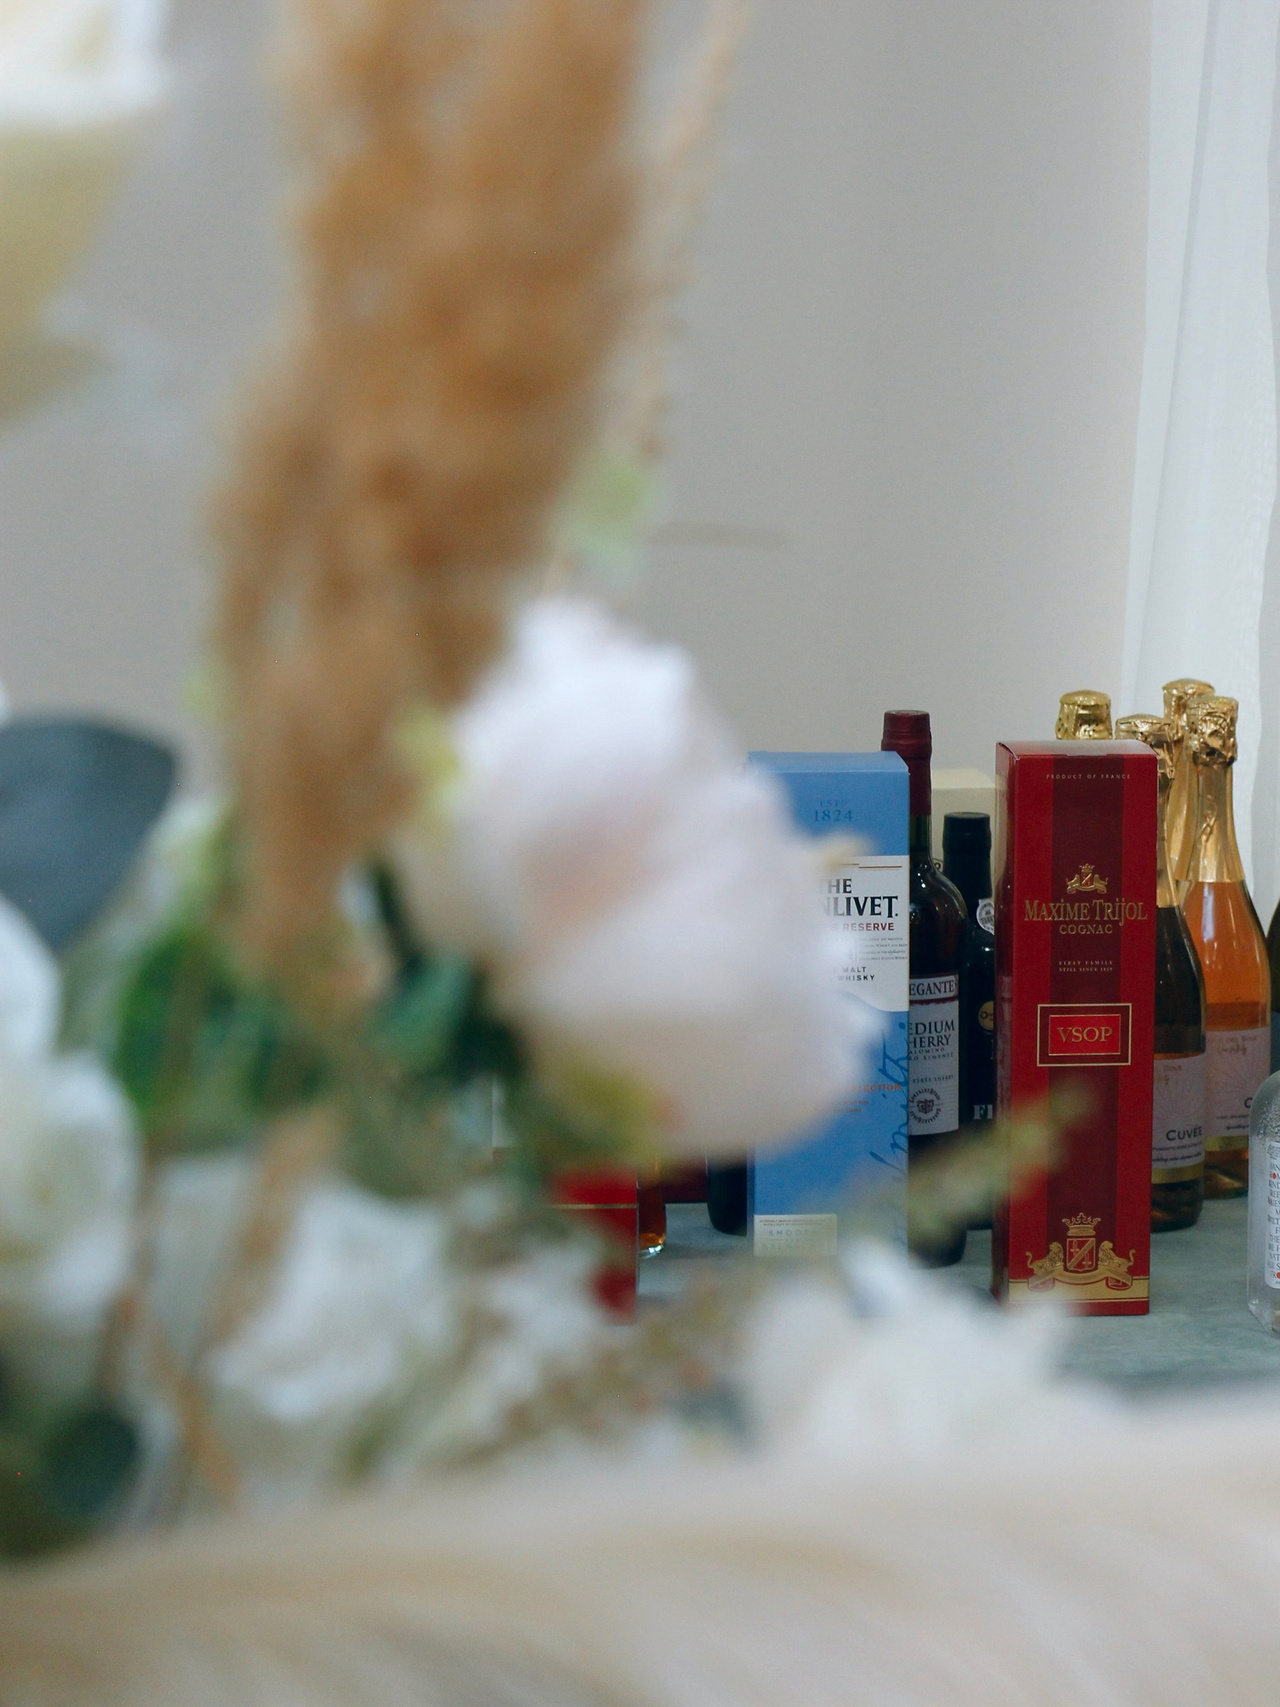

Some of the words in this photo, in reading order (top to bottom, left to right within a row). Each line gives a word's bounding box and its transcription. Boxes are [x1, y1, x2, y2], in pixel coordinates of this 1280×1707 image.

[815, 809, 853, 821] 1824
[1059, 924, 1113, 934] COGNAC
[1056, 1025, 1113, 1044] VSOP
